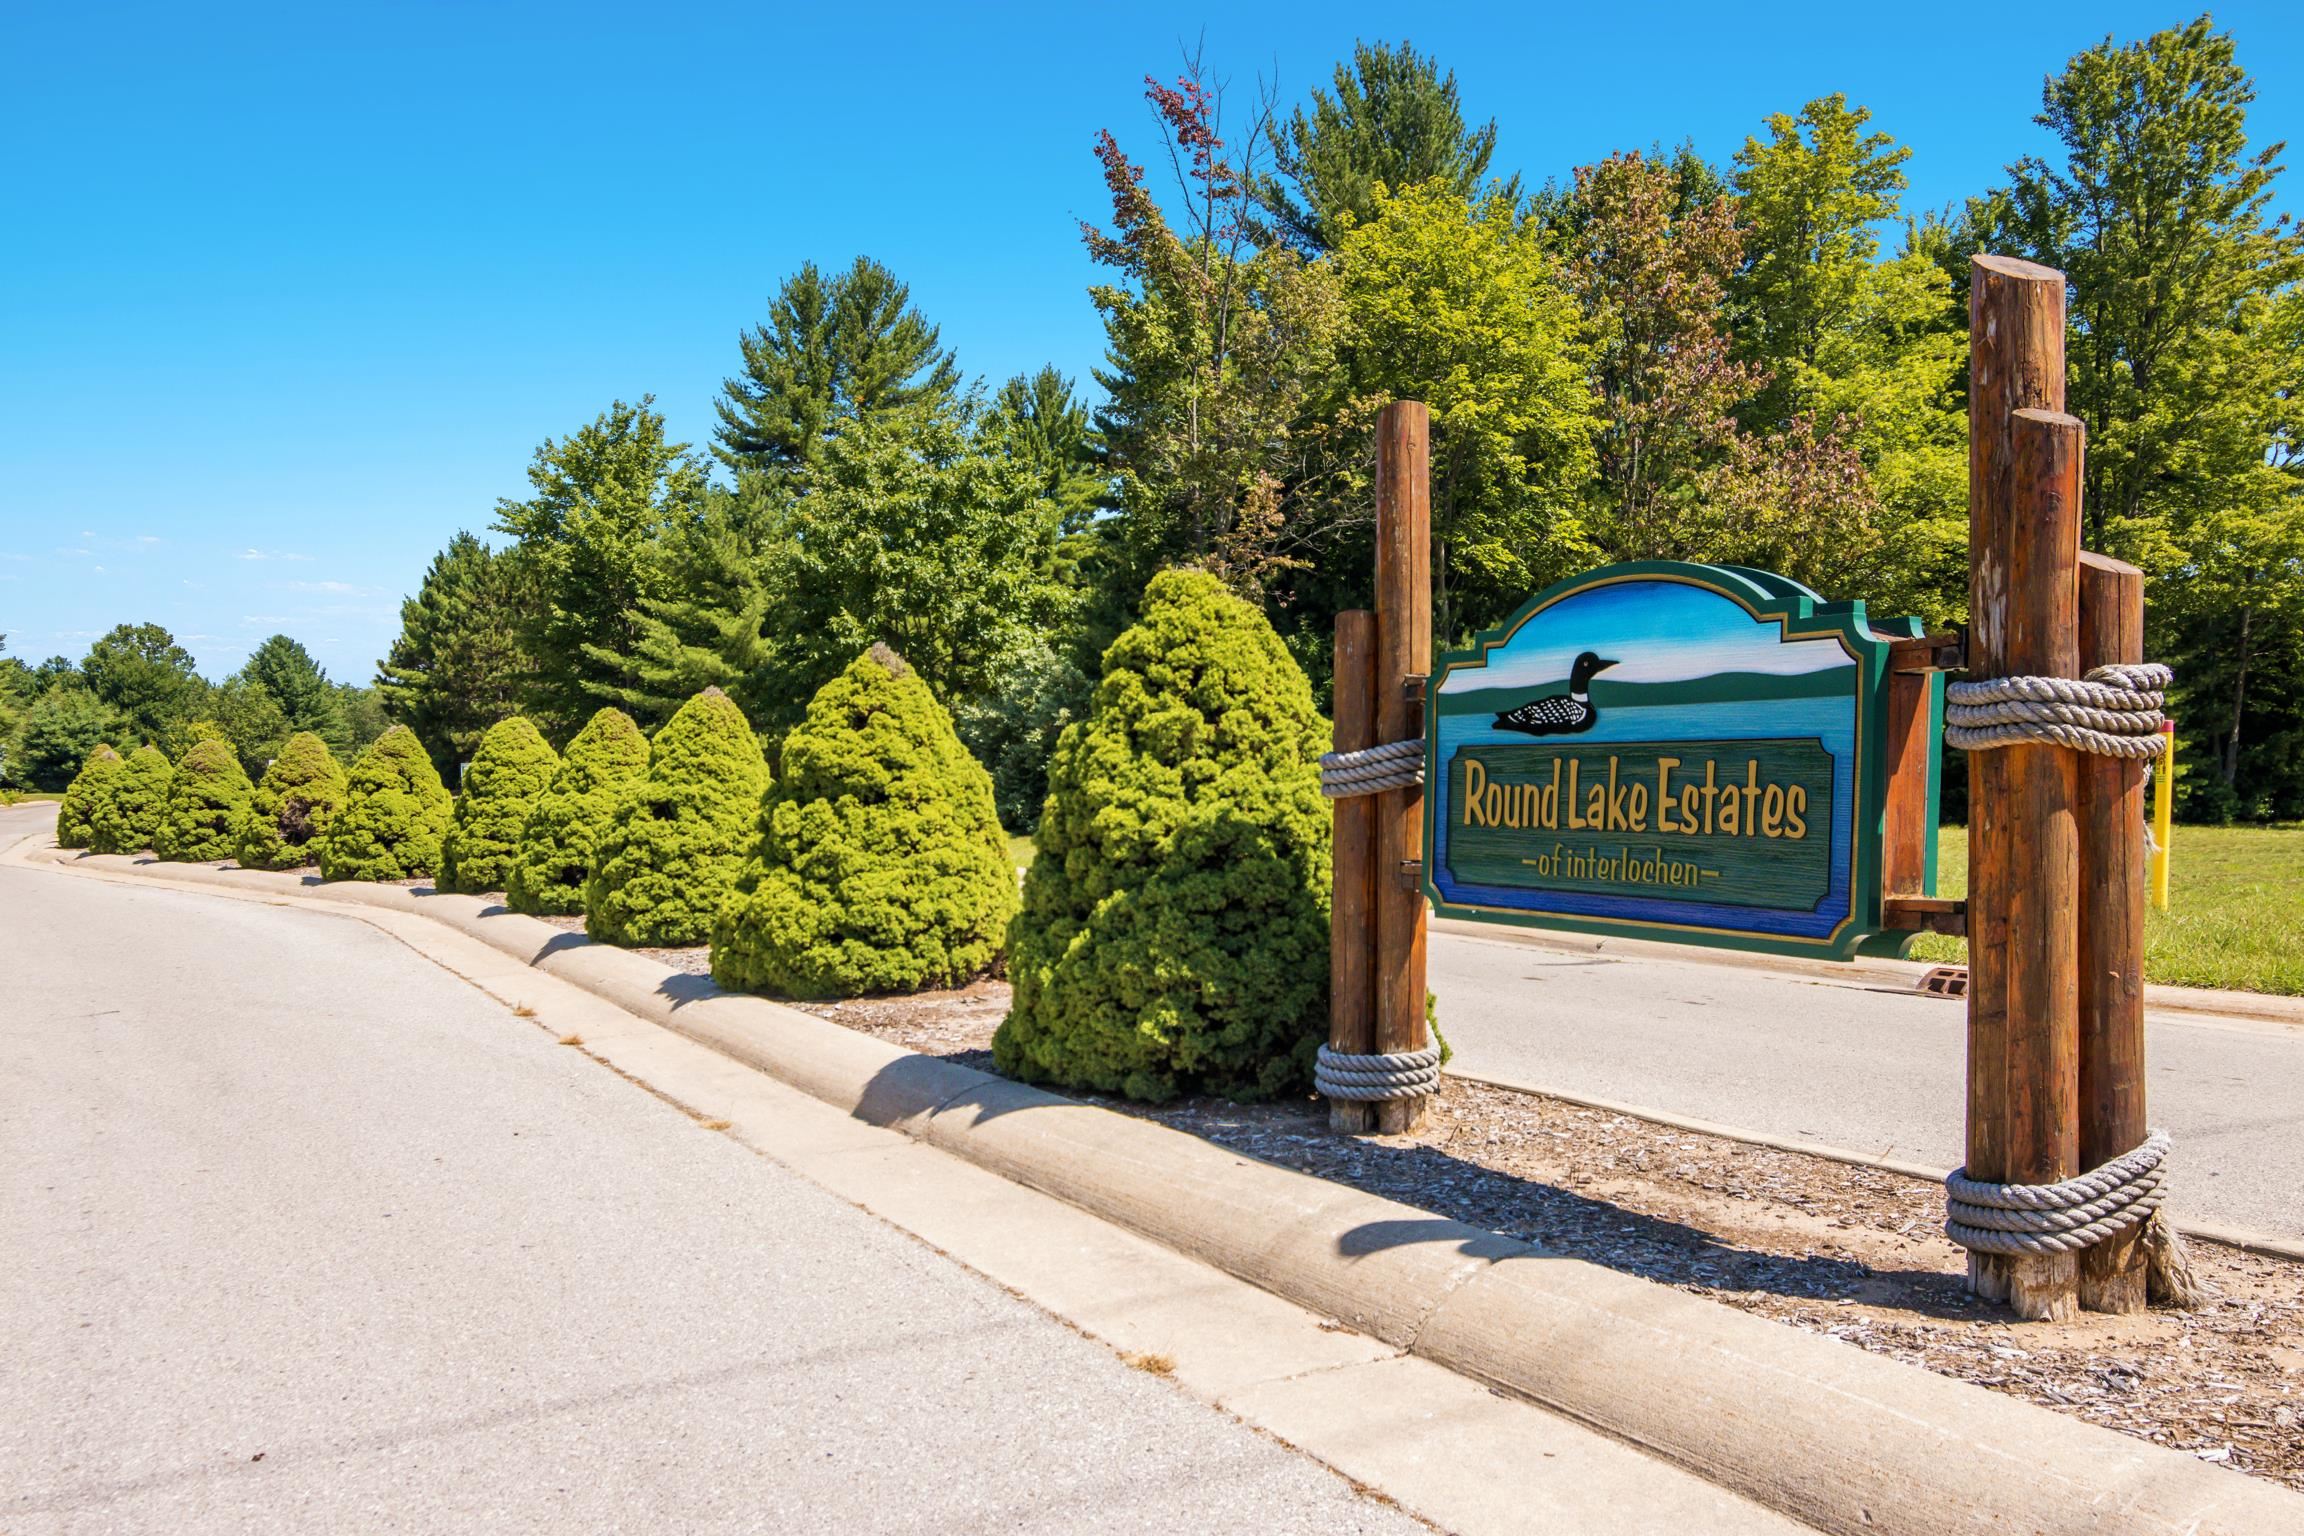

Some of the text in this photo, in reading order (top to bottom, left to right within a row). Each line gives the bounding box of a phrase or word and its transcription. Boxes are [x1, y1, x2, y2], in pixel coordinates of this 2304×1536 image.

[1463, 755, 1807, 839] Round Lake Estates
